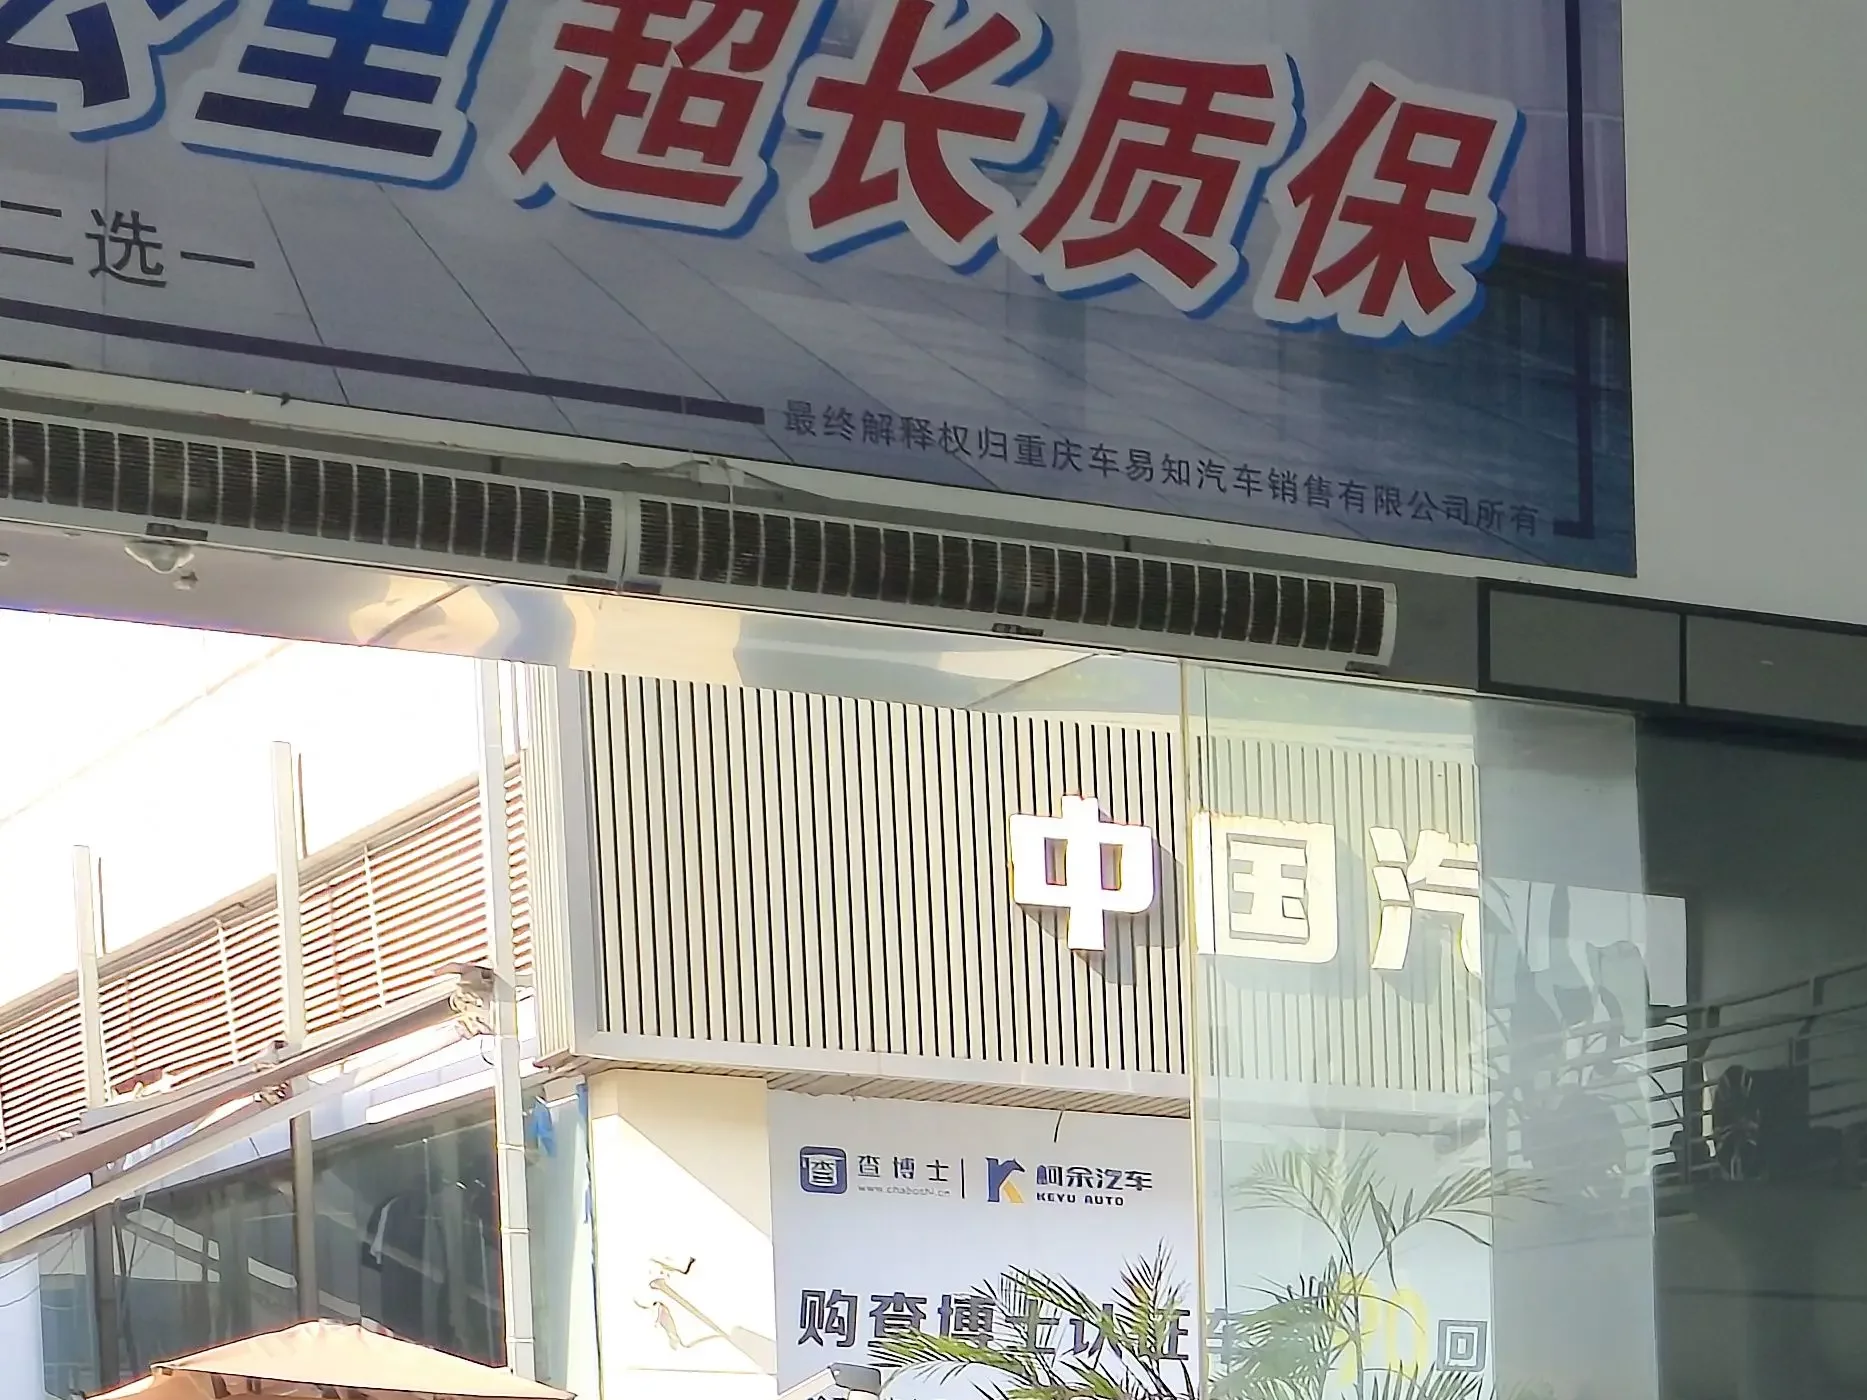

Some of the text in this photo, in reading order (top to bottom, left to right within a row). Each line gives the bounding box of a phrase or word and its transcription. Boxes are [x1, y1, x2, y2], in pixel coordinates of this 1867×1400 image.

[783, 400, 1539, 537] 最终解释权归重庆车易知汽车销售有限公司所有
[1009, 795, 1481, 973] 中国汽
[857, 1154, 950, 1182] 查博士
[1036, 1192, 1124, 1206] KEYU AUTO
